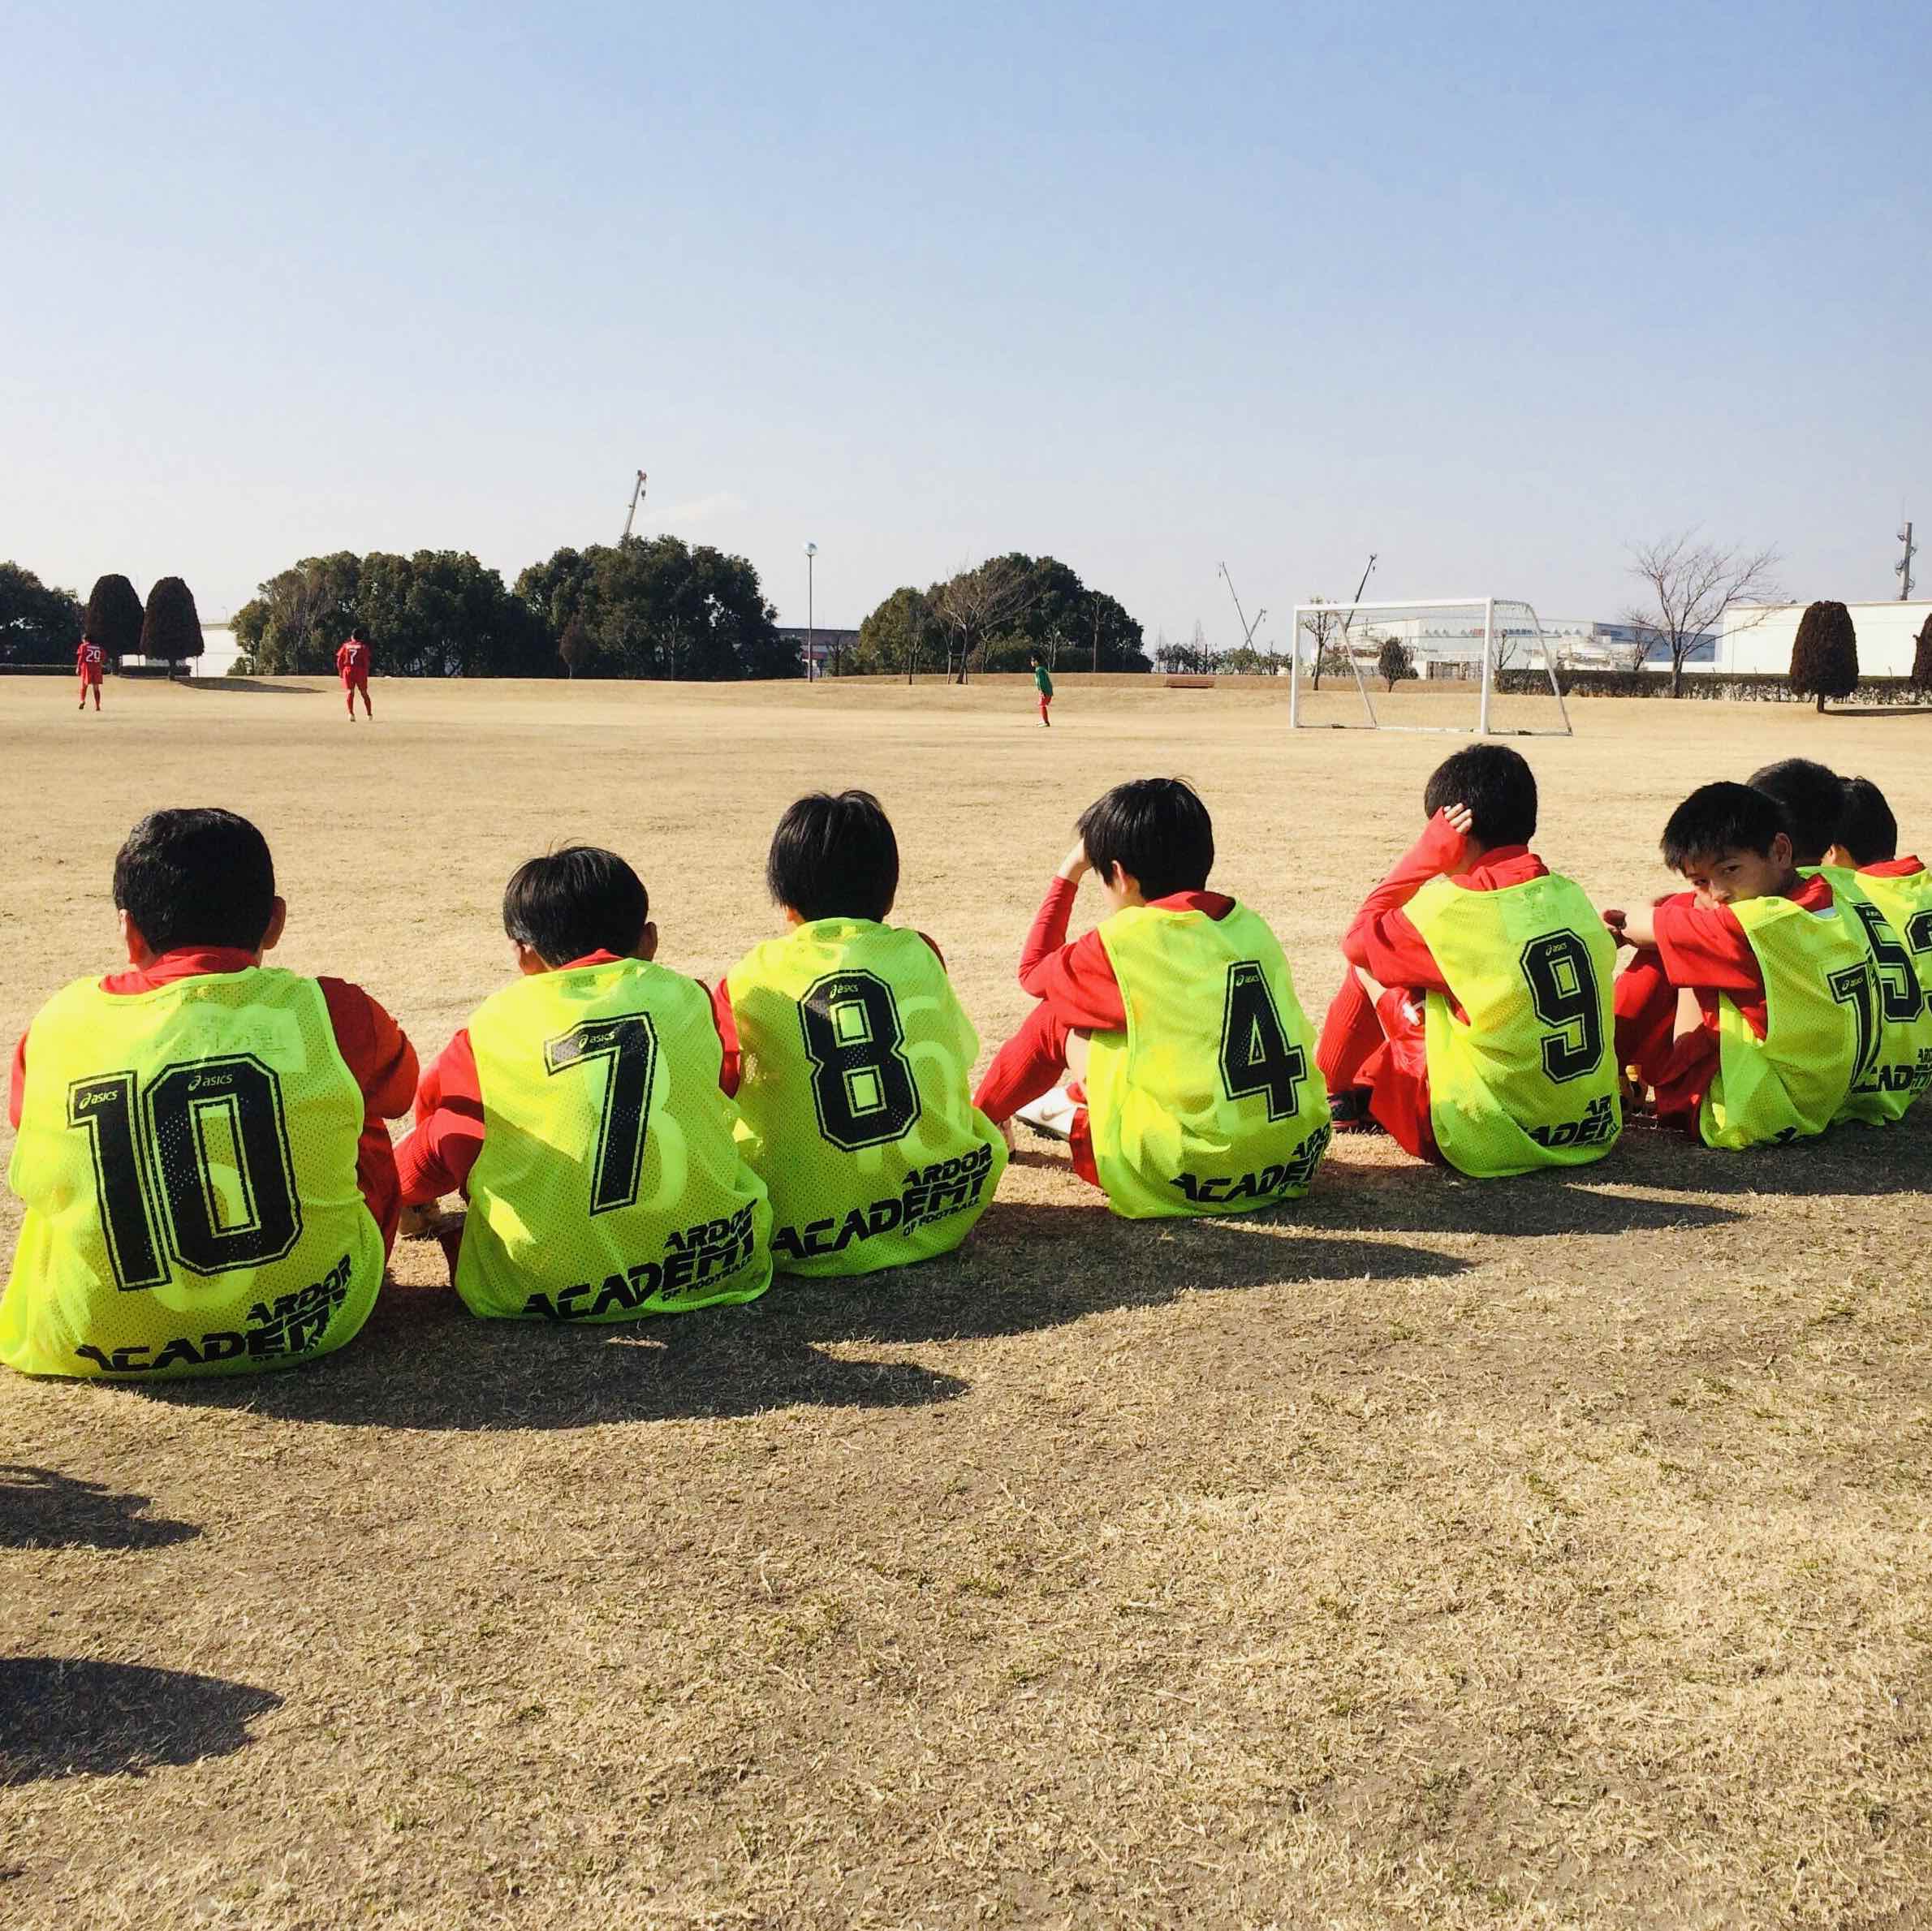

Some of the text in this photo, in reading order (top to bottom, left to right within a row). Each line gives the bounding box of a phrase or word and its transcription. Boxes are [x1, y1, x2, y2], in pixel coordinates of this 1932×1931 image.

[349, 649, 358, 665] 7
[796, 968, 921, 1152] 8
[1218, 960, 1307, 1123] 4
[1520, 928, 1605, 1084] 9
[67, 1053, 303, 1291] 10
[544, 1011, 658, 1217] 7
[903, 1142, 992, 1187] ARDOR
